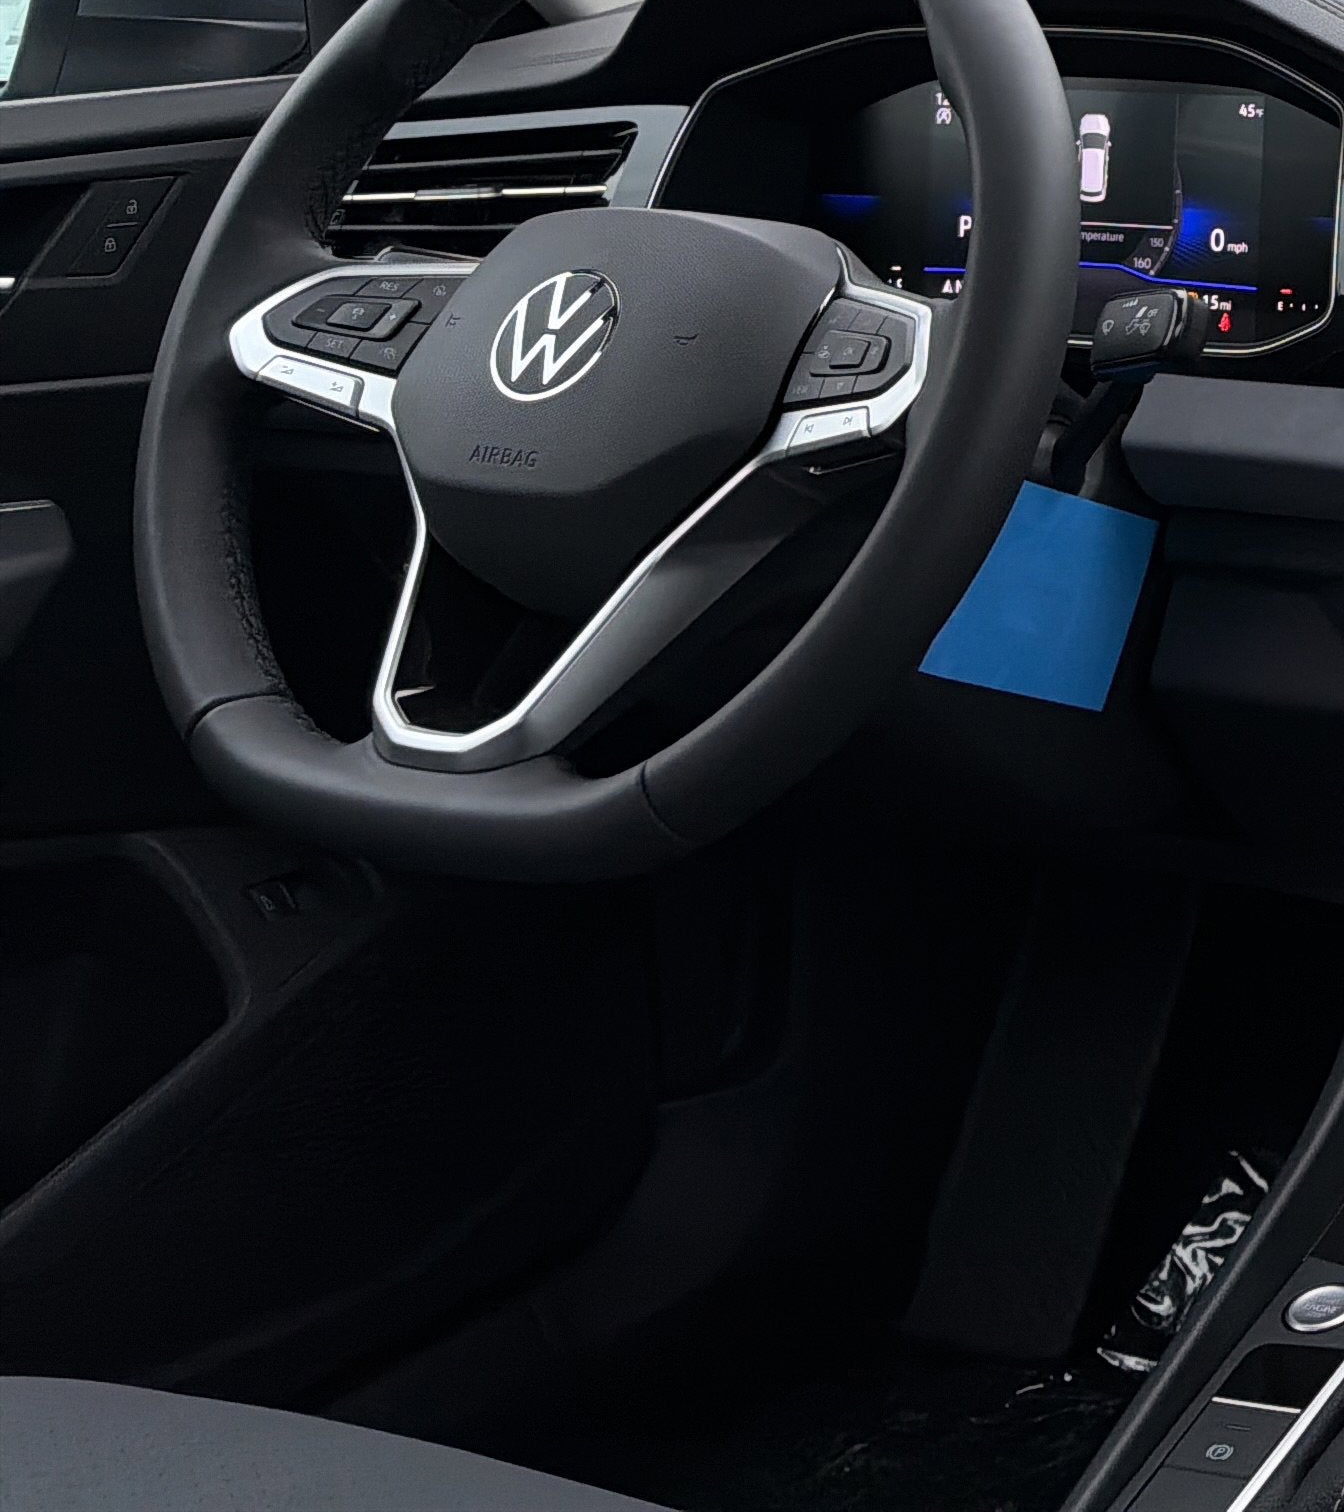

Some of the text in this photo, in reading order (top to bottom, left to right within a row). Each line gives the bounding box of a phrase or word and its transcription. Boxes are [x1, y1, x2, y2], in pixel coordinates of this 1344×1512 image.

[1209, 227, 1249, 255] 0 mph
[1132, 256, 1152, 270] 160
[1219, 300, 1232, 311] mi
[468, 444, 540, 468] AIRBAG
